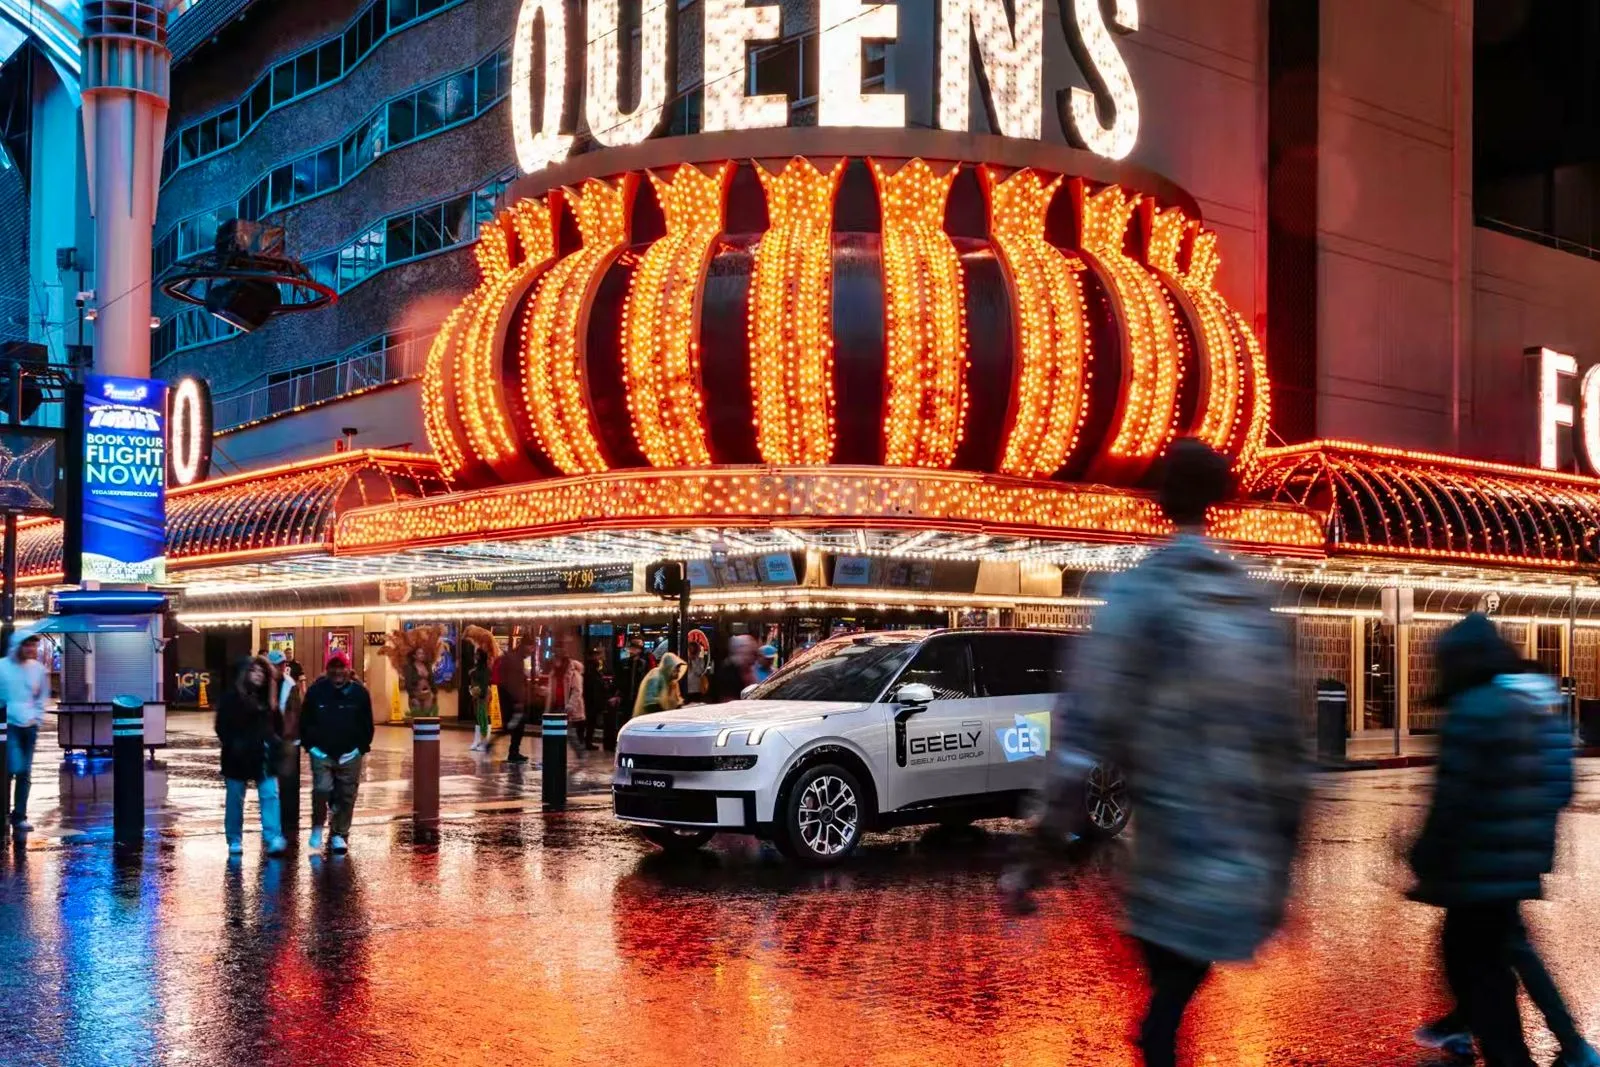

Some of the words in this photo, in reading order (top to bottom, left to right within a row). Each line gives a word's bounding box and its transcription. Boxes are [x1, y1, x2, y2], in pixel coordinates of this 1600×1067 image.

[511, 0, 1140, 174] QUEENS
[87, 433, 125, 445] BOOK
[128, 435, 163, 447] YOUR
[87, 445, 163, 466] FLIGHT
[86, 464, 163, 486] NOW!
[437, 581, 456, 593] Prime
[457, 579, 469, 592] Rib
[470, 577, 494, 591] Dinner
[910, 731, 982, 755] GEELY
[1004, 727, 1042, 753] CES
[910, 757, 935, 766] GEELY
[936, 754, 957, 763] AUTO
[958, 751, 985, 760] GROUP
